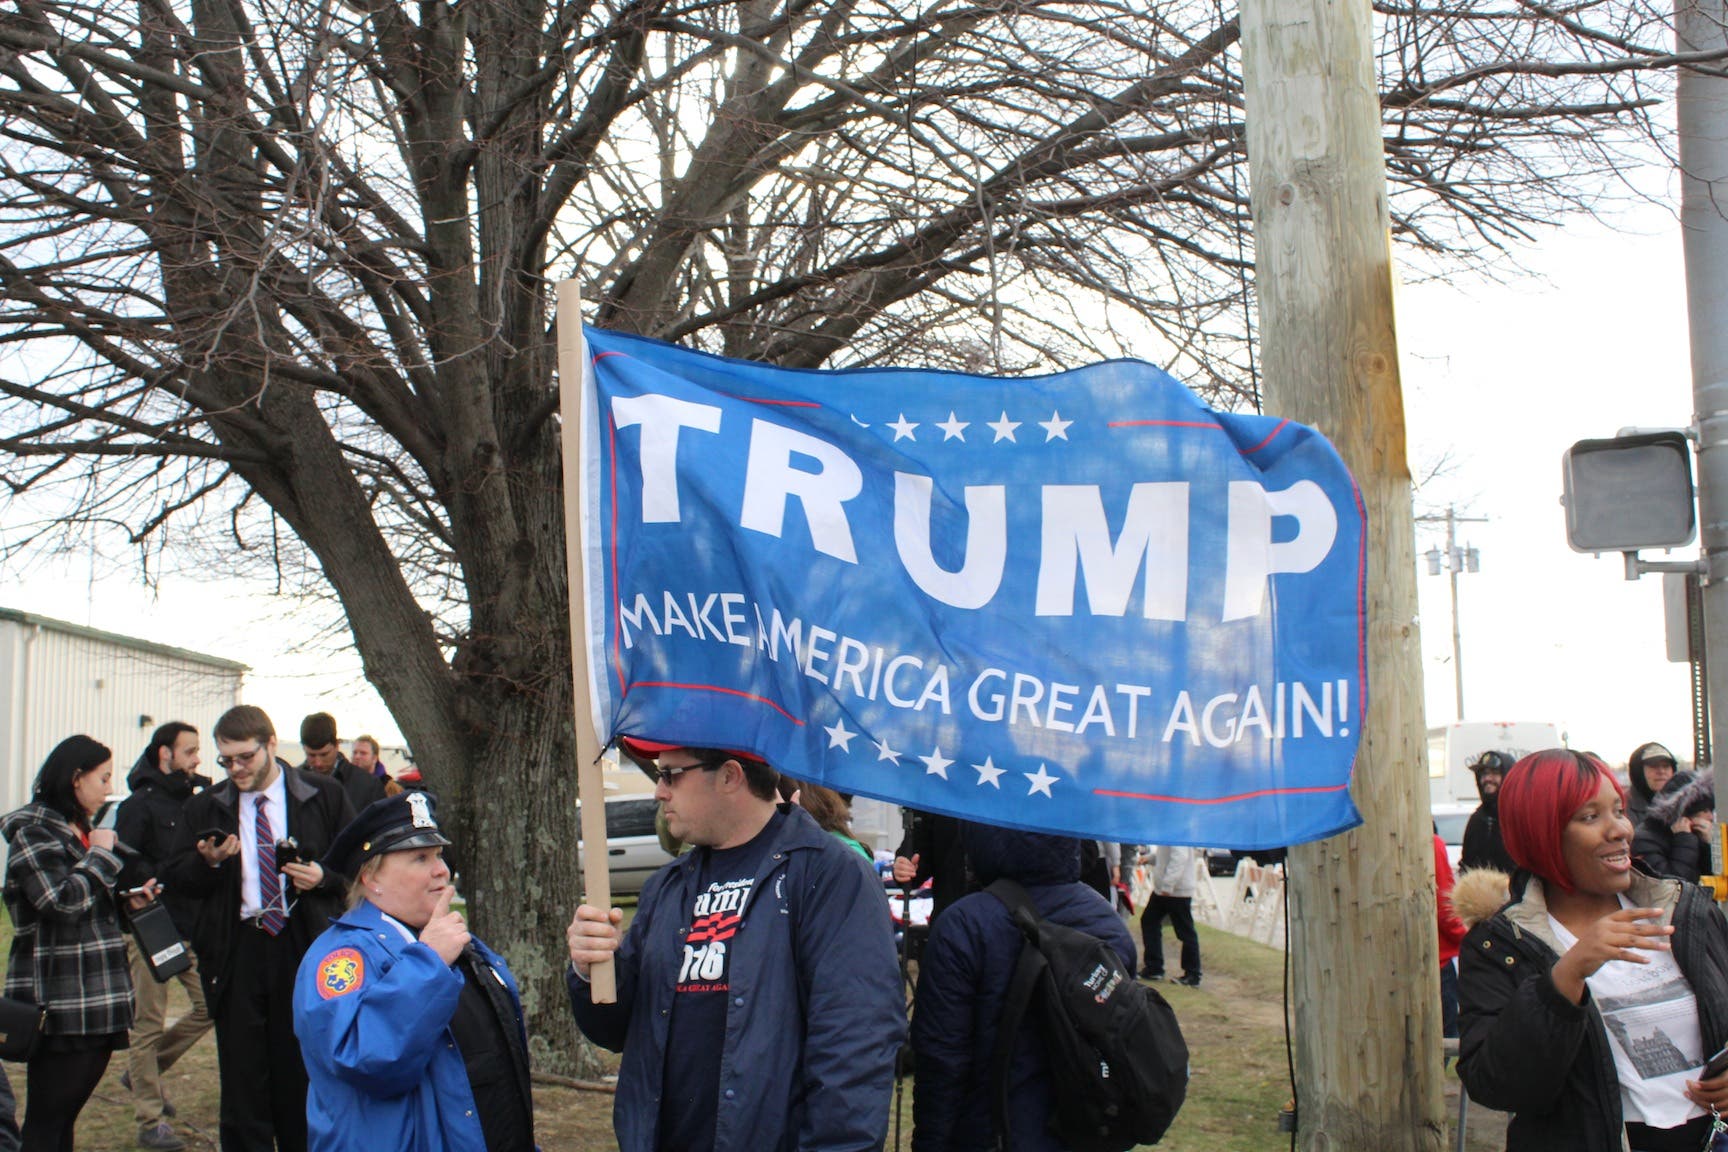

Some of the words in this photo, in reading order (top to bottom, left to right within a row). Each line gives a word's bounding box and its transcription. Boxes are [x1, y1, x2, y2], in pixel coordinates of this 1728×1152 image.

[611, 393, 1338, 622] TRUMP
[620, 590, 751, 649] MAKE
[754, 602, 951, 714] AMERICA
[968, 667, 1151, 739] GREAT
[1162, 679, 1350, 748] AGAIN!
